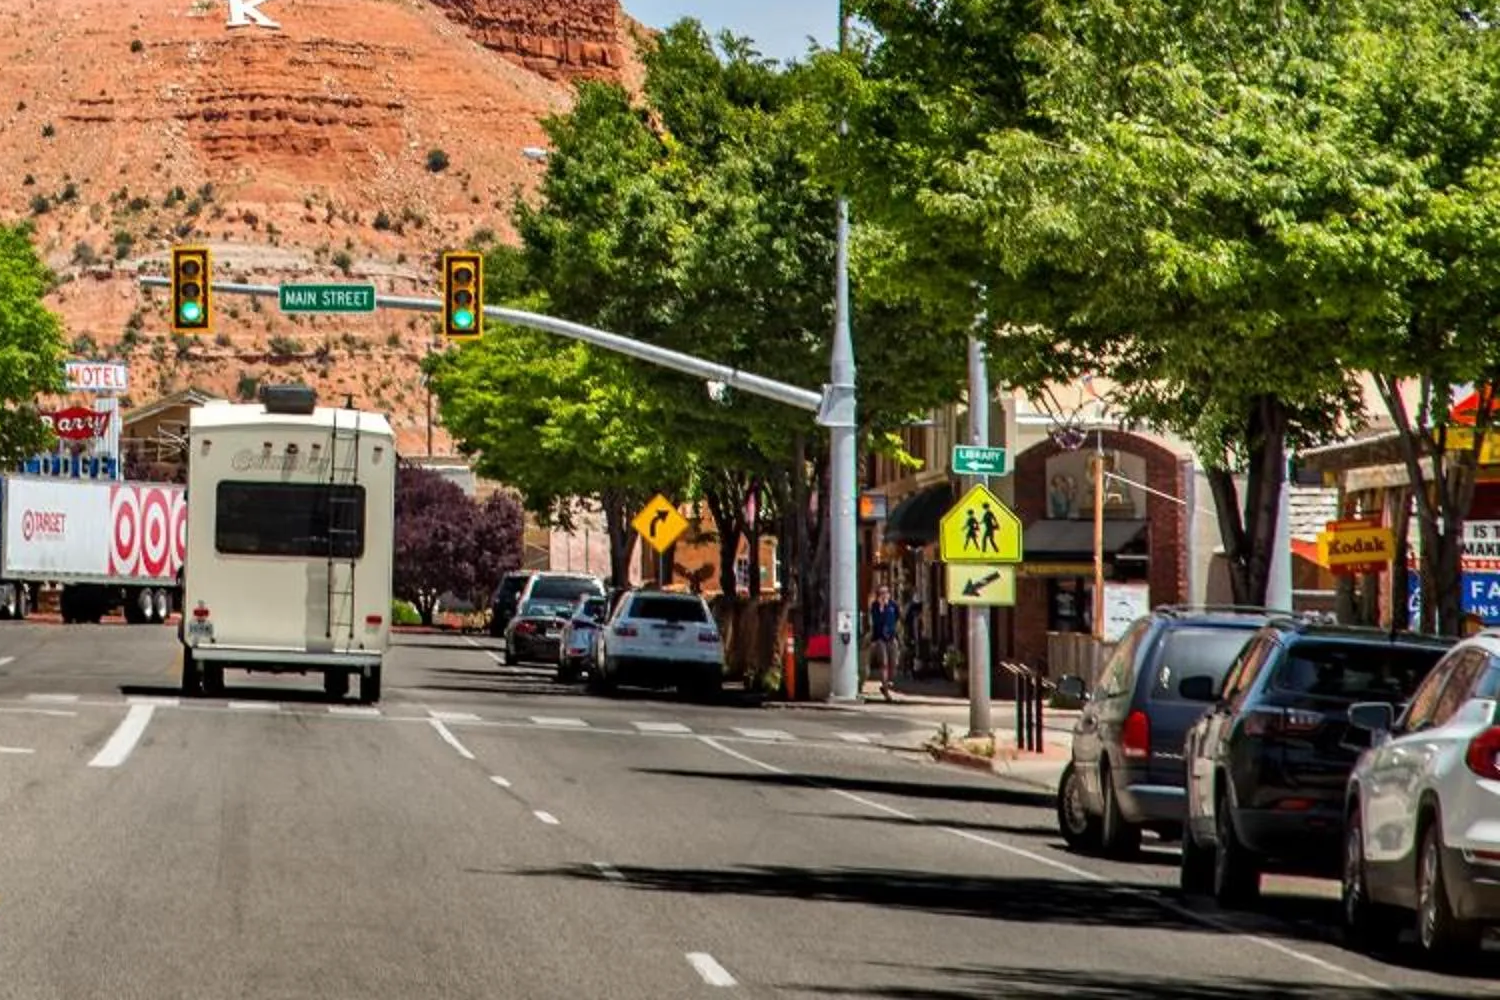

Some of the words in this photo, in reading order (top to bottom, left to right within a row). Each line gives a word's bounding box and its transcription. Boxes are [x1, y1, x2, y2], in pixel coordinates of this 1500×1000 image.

[285, 290, 317, 306] MAIN
[321, 290, 368, 306] STREET
[68, 365, 123, 387] MOTEL
[958, 448, 1001, 462] LIBRARY
[34, 511, 67, 533] TARGET
[1328, 536, 1386, 556] Kodak
